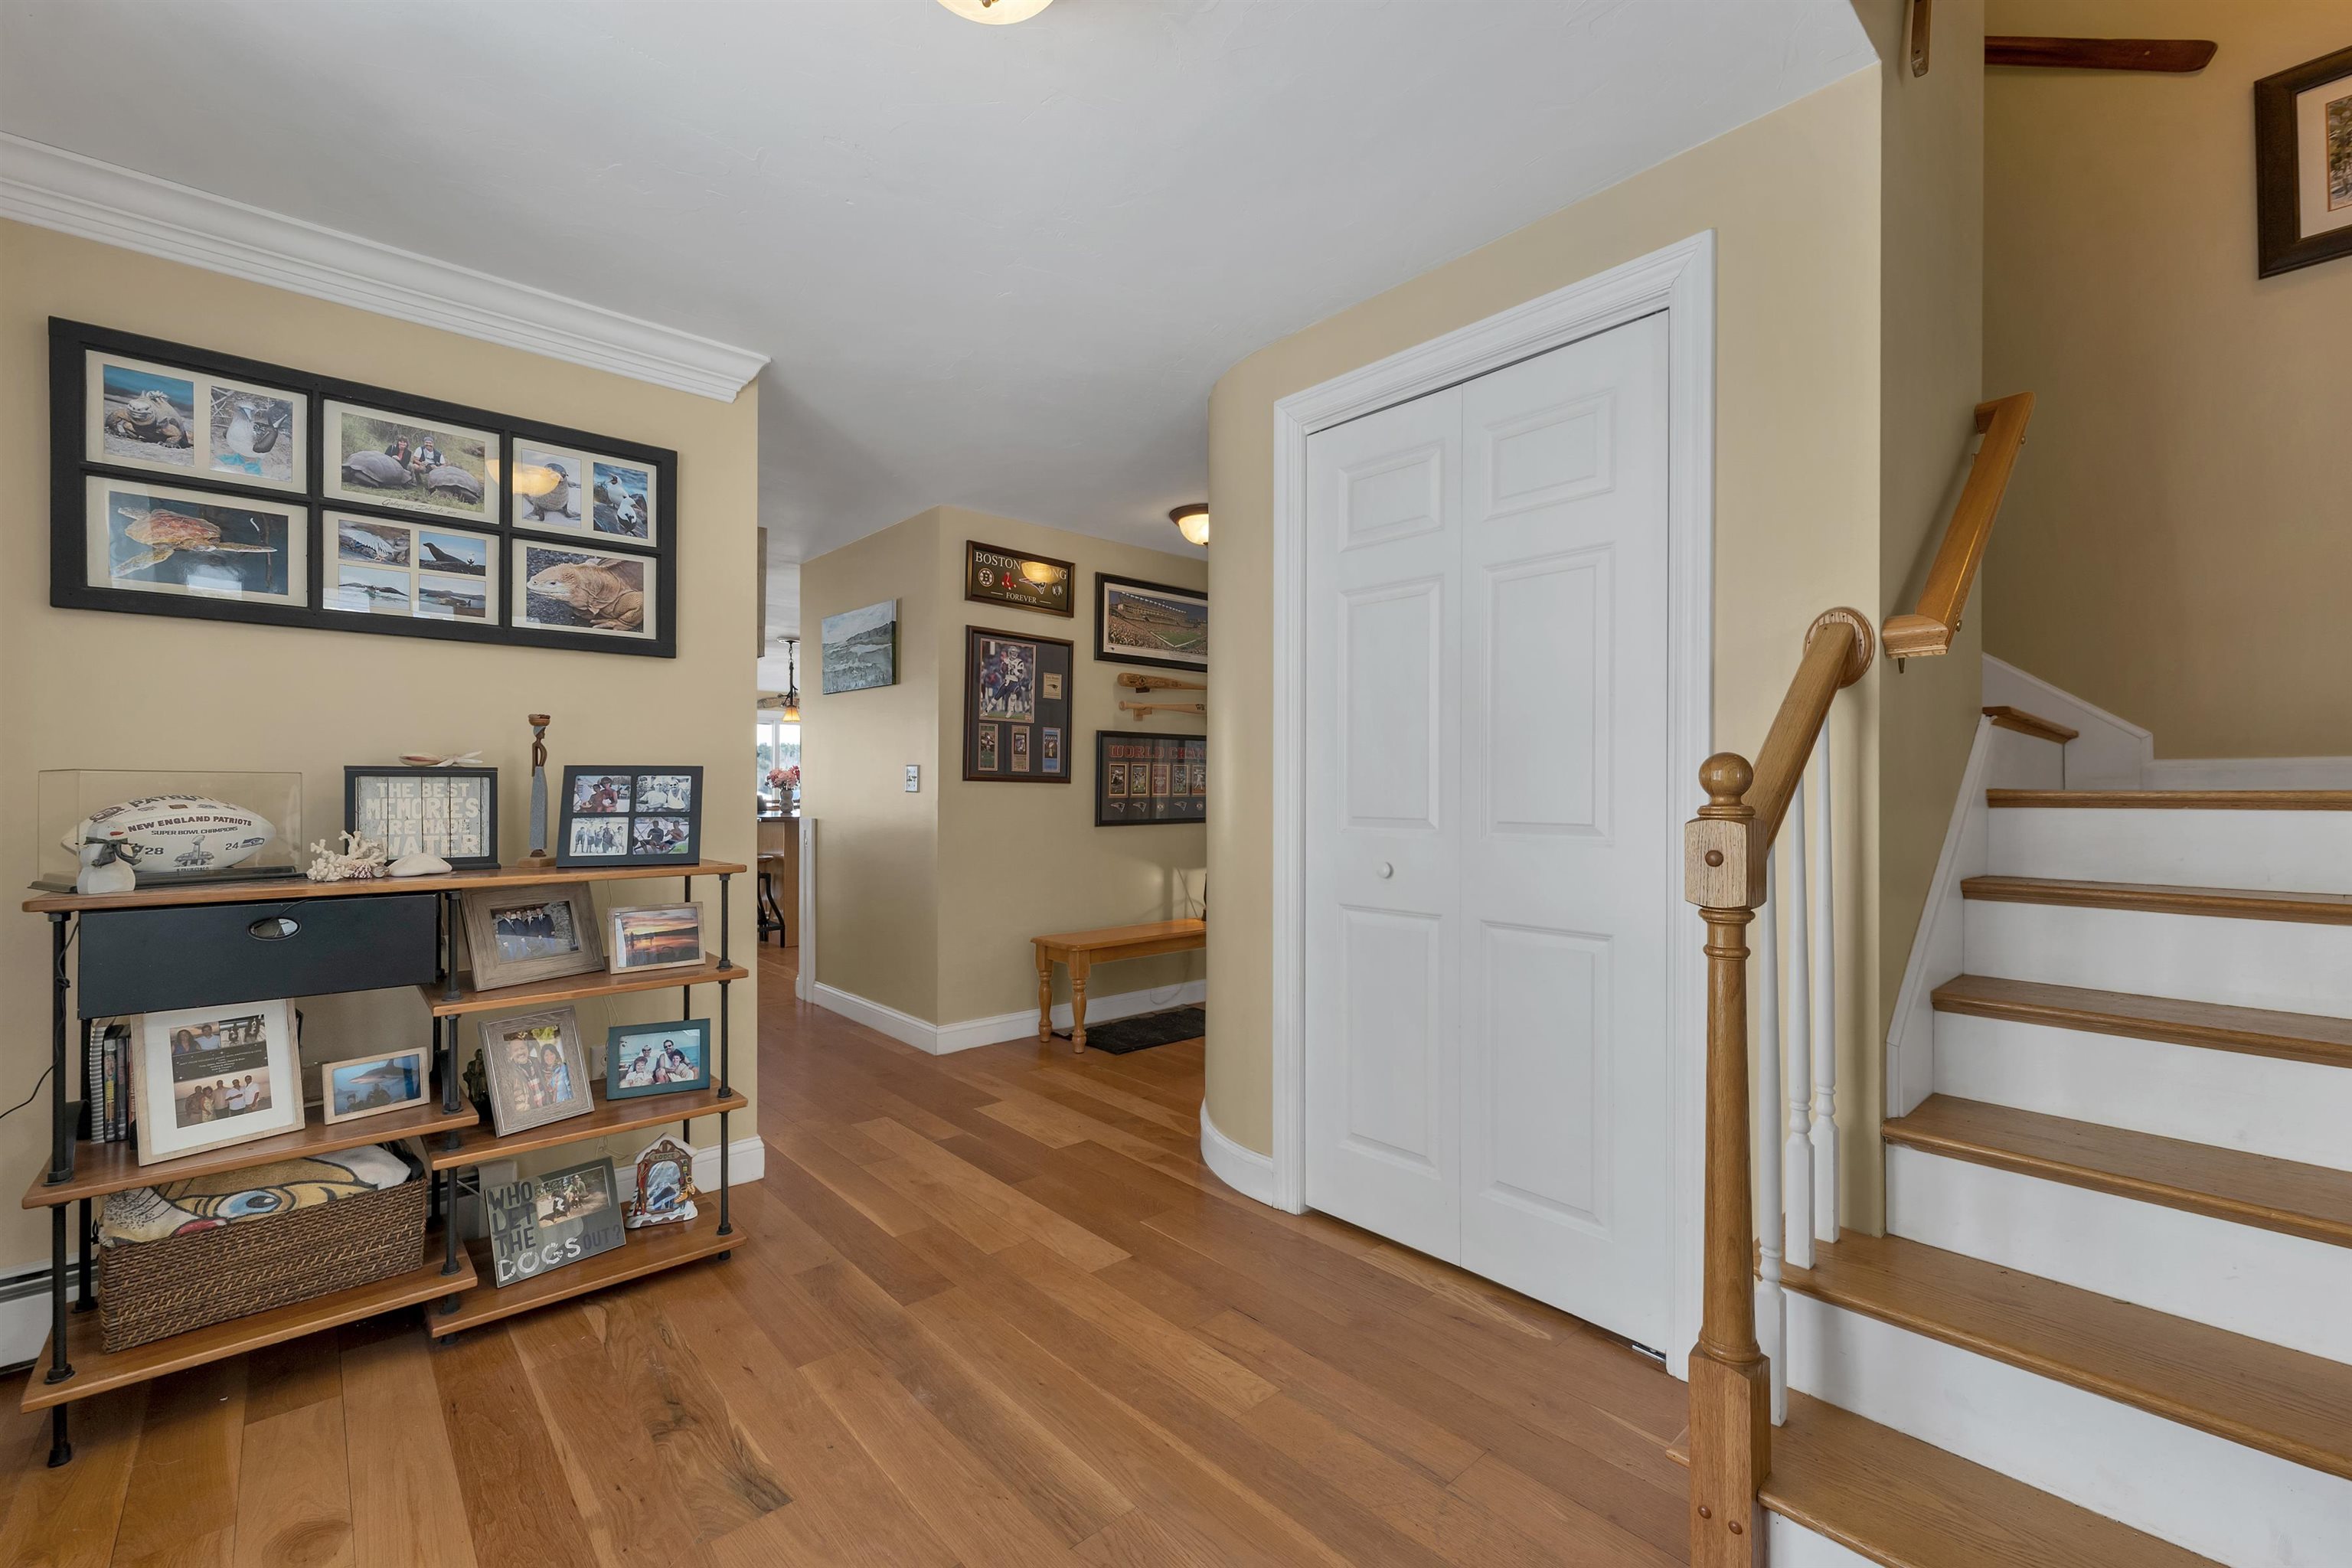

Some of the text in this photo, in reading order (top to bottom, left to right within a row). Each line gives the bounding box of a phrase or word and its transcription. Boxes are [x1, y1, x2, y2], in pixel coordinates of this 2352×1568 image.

[975, 551, 1021, 570] BOSTON
[1006, 592, 1037, 603] FOREVER
[1108, 745, 1165, 759] WORLD
[376, 782, 470, 798] THE BEST
[366, 797, 479, 819] MEMORIES
[127, 815, 252, 832] NEW ENGLAND PATRIOTS
[377, 818, 471, 835] ARE MADE
[145, 847, 164, 855] 28
[225, 842, 240, 851] 24
[381, 834, 481, 856] WATER
[487, 1181, 533, 1210] WHO
[492, 1202, 535, 1236] LET
[495, 1226, 537, 1257] THE
[497, 1236, 582, 1282] DOGS
